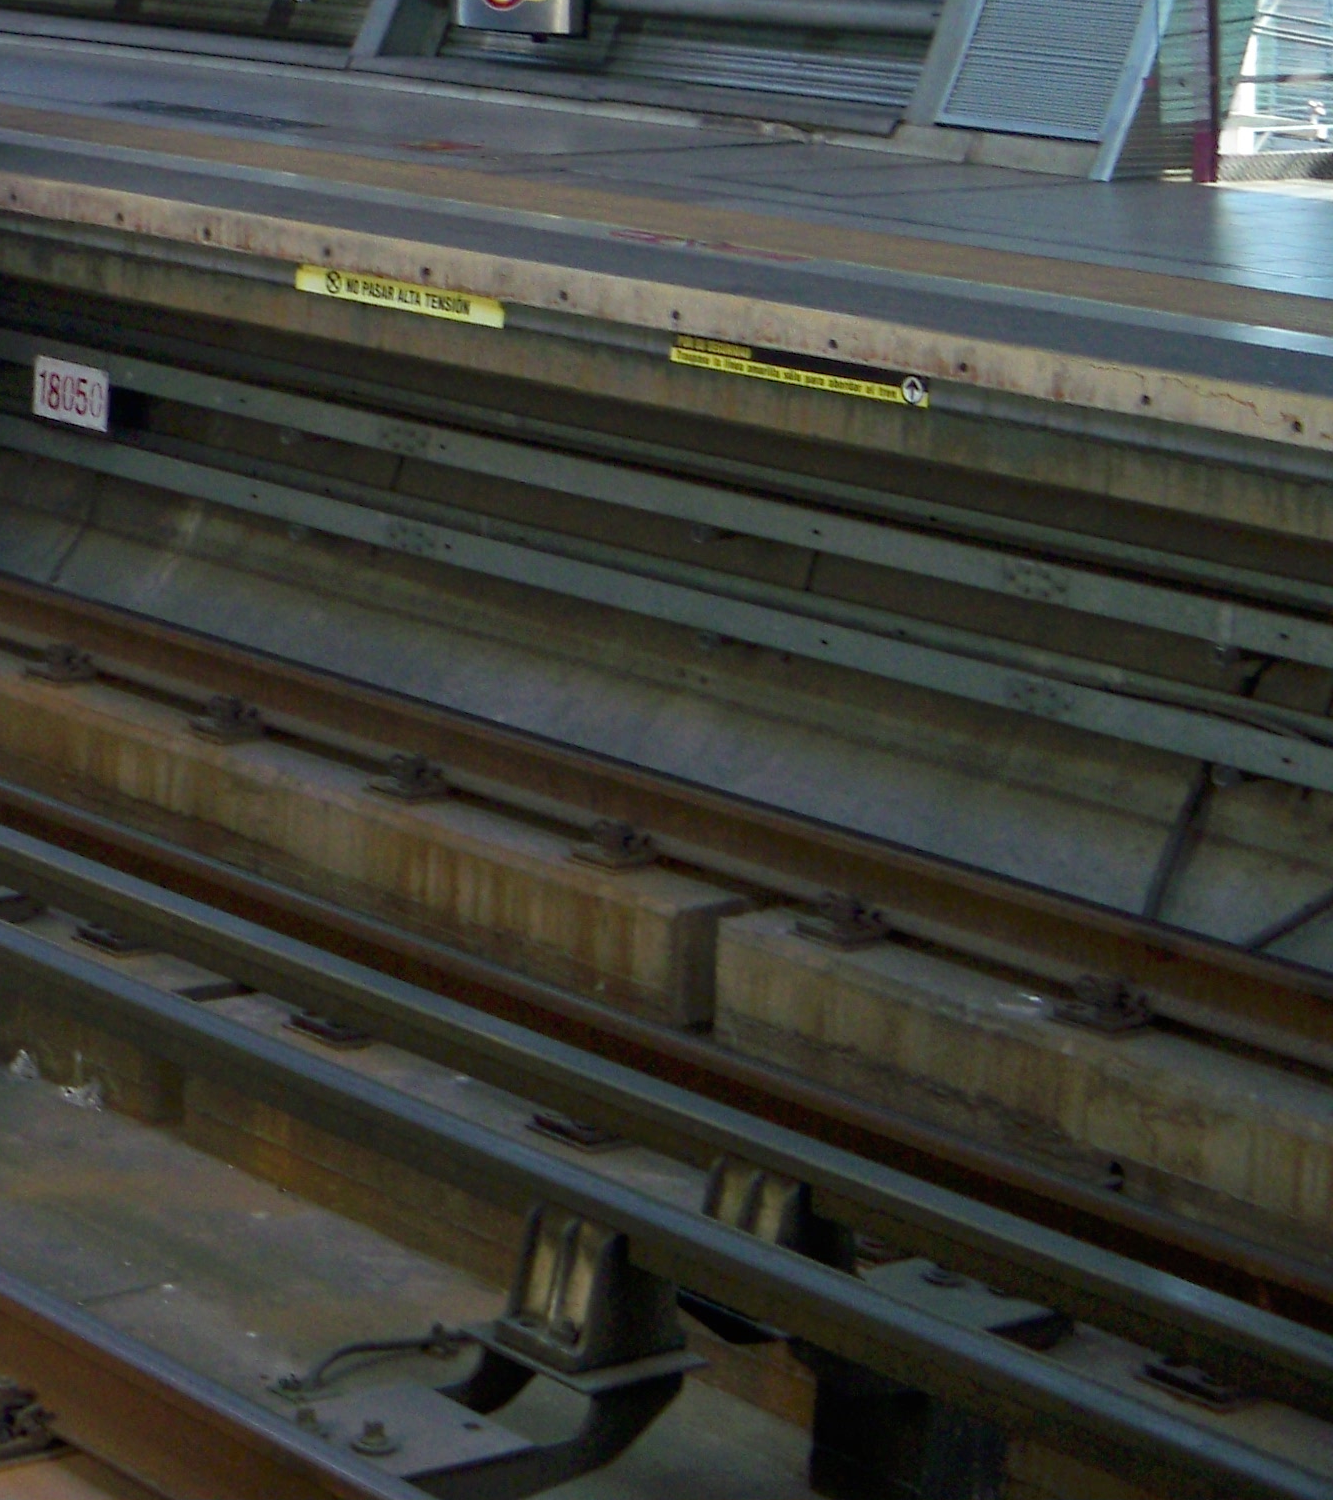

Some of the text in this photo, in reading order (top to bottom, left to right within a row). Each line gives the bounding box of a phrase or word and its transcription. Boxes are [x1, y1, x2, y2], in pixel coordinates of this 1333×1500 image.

[346, 279, 471, 315] NO PASAR ALTA TENSIÓN
[39, 369, 103, 419] 18050
